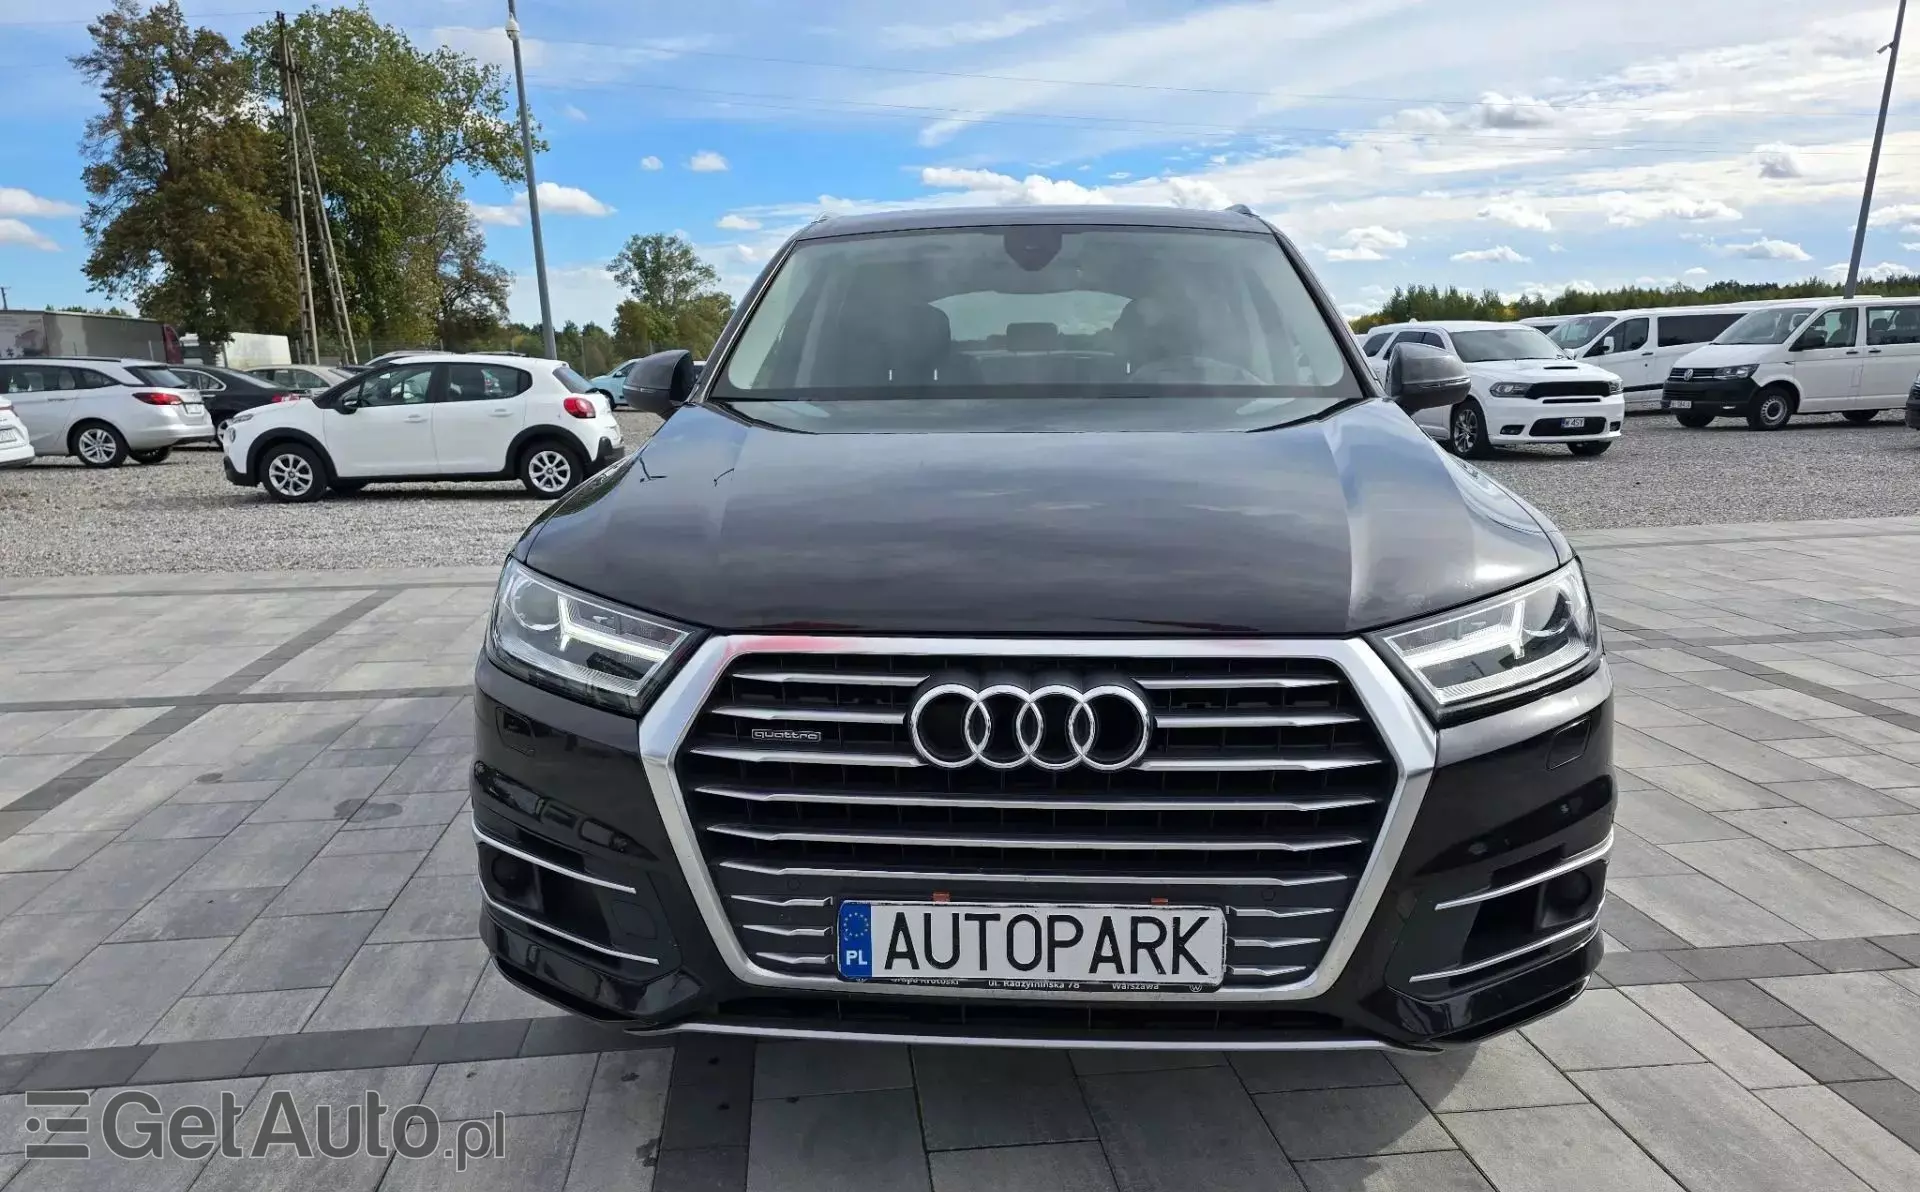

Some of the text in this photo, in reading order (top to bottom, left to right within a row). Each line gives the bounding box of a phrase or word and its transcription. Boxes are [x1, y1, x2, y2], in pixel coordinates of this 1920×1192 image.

[754, 730, 818, 740] quattro
[884, 911, 1210, 976] AUTOPARK
[846, 949, 868, 966] PL
